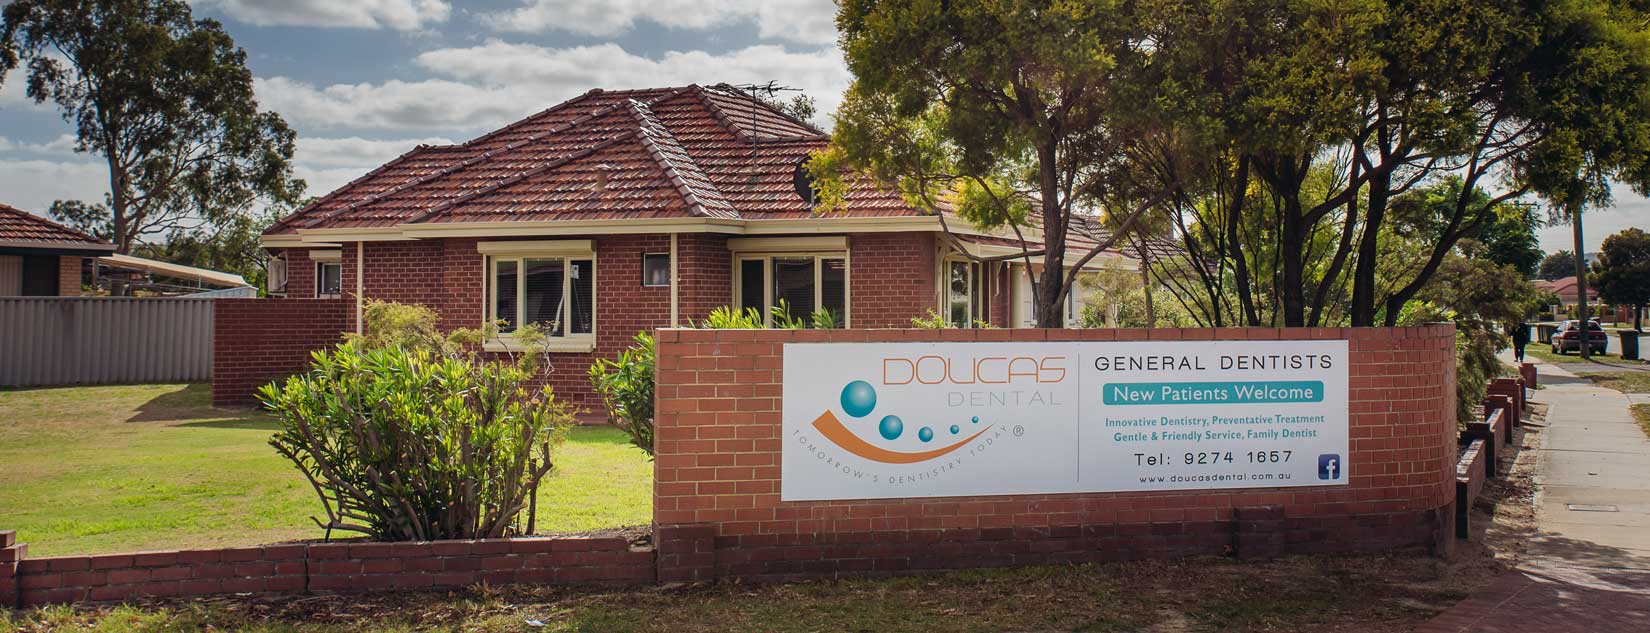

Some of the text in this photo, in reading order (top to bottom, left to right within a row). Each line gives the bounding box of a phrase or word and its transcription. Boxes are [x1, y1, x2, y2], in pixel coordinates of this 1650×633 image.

[884, 355, 1066, 385] DOUCAS
[1095, 354, 1332, 371] GENERAL DENTISTS
[948, 391, 1062, 407] DENTAL
[1114, 385, 1313, 401] New Patients Welcome
[1105, 414, 1325, 427] Innovative Dentistry, Preventative Treatment
[1114, 429, 1316, 442] Gentle & Friendly Service, Family Dentist
[793, 425, 1007, 484] TOMORROW'S DENTISTRY TODAY
[1134, 451, 1292, 466] Tel: 9274 1657
[1139, 472, 1291, 482] www.doucasdental.com.au
